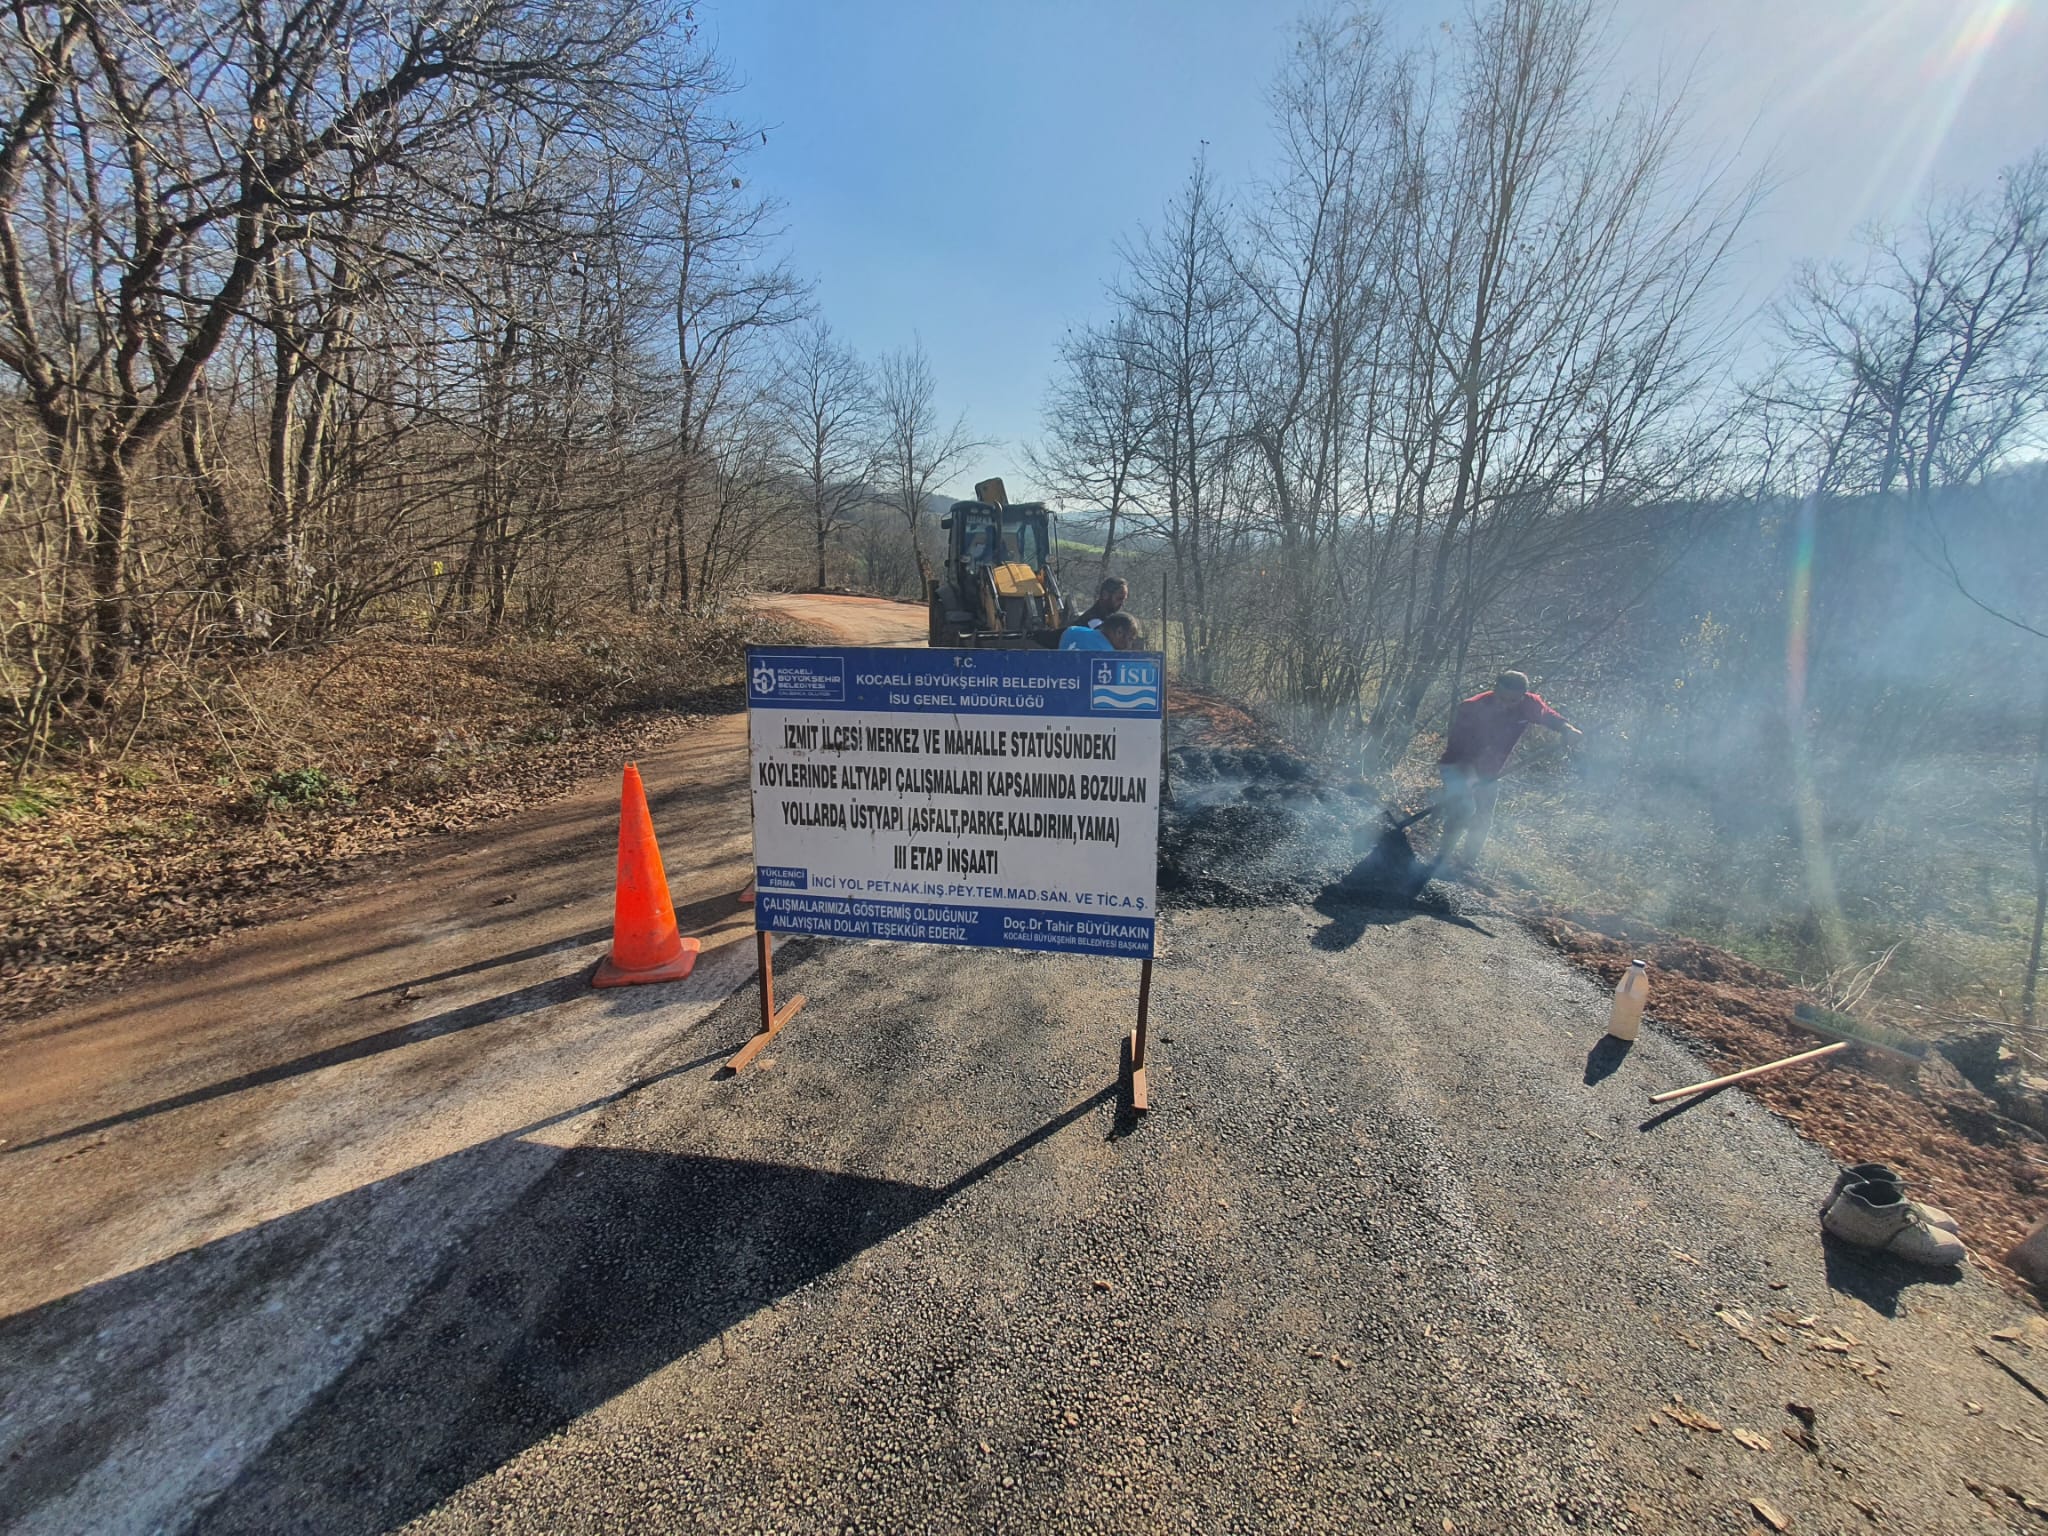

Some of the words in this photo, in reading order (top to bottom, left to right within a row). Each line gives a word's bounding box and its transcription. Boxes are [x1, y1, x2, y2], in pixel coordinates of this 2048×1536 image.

[954, 658, 976, 668] T.C.
[856, 675, 911, 686] KOCAELİ
[915, 676, 998, 688] BÜYÜKŞEHİR
[1002, 676, 1080, 689] BELEDİYESİ
[1120, 666, 1154, 684] İSU
[889, 693, 910, 705] İSU
[914, 694, 956, 706] GENEL
[960, 694, 1044, 708] MÜDÜRLÜĞÜ
[784, 717, 818, 748] İZMİT
[822, 719, 862, 758] İLÇESİ
[866, 729, 920, 753] MERKEZ
[923, 732, 940, 754] VE
[944, 732, 1007, 757] MAHALLE
[1010, 725, 1116, 760] STATÜSÜNDEKİ
[760, 756, 837, 789] KÖYLERİNDE
[841, 768, 891, 790] ALTYAPI
[896, 768, 982, 800] ÇALIŞMALARI
[987, 771, 1076, 799] KAPSAMINDA
[1080, 775, 1146, 802] BOZULAN
[782, 801, 846, 828] YOLLARDA
[850, 798, 903, 829] ÜSTYAPI
[908, 807, 1120, 848] (ASFALT,PARKE,KALDIRIM,YAMA)
[894, 845, 907, 868] III
[911, 847, 943, 872] ETAP
[947, 841, 998, 880] İNŞAATI
[770, 878, 796, 888] FİRMA
[812, 875, 835, 889] İNCİ
[839, 877, 864, 890] YOL
[867, 880, 1071, 903] PET.NAK.İNŞ.PEY.TEM.MAD.SAN.
[1076, 893, 1093, 904] VE
[1097, 893, 1148, 910] TİC.A.Ş.
[763, 897, 850, 916] ÇALIŞMALARIMIZA
[853, 902, 911, 921] GÖSTERMİŞ
[914, 905, 978, 923] OLDUĞUNUZ
[773, 915, 830, 932] ANLAYIŞTAN
[834, 918, 870, 933] DOLAYI
[873, 922, 924, 938] TEŞEKKÜR
[1045, 920, 1074, 934] Tahir
[1077, 920, 1149, 939] BÜYÜKAKIN
[1003, 931, 1032, 939] KOCAELİ
[1033, 934, 1075, 944] BÜYÜKŞEHİR
[1077, 937, 1116, 948] BELEDİYESİ
[1118, 940, 1148, 951] BAŞKANI
